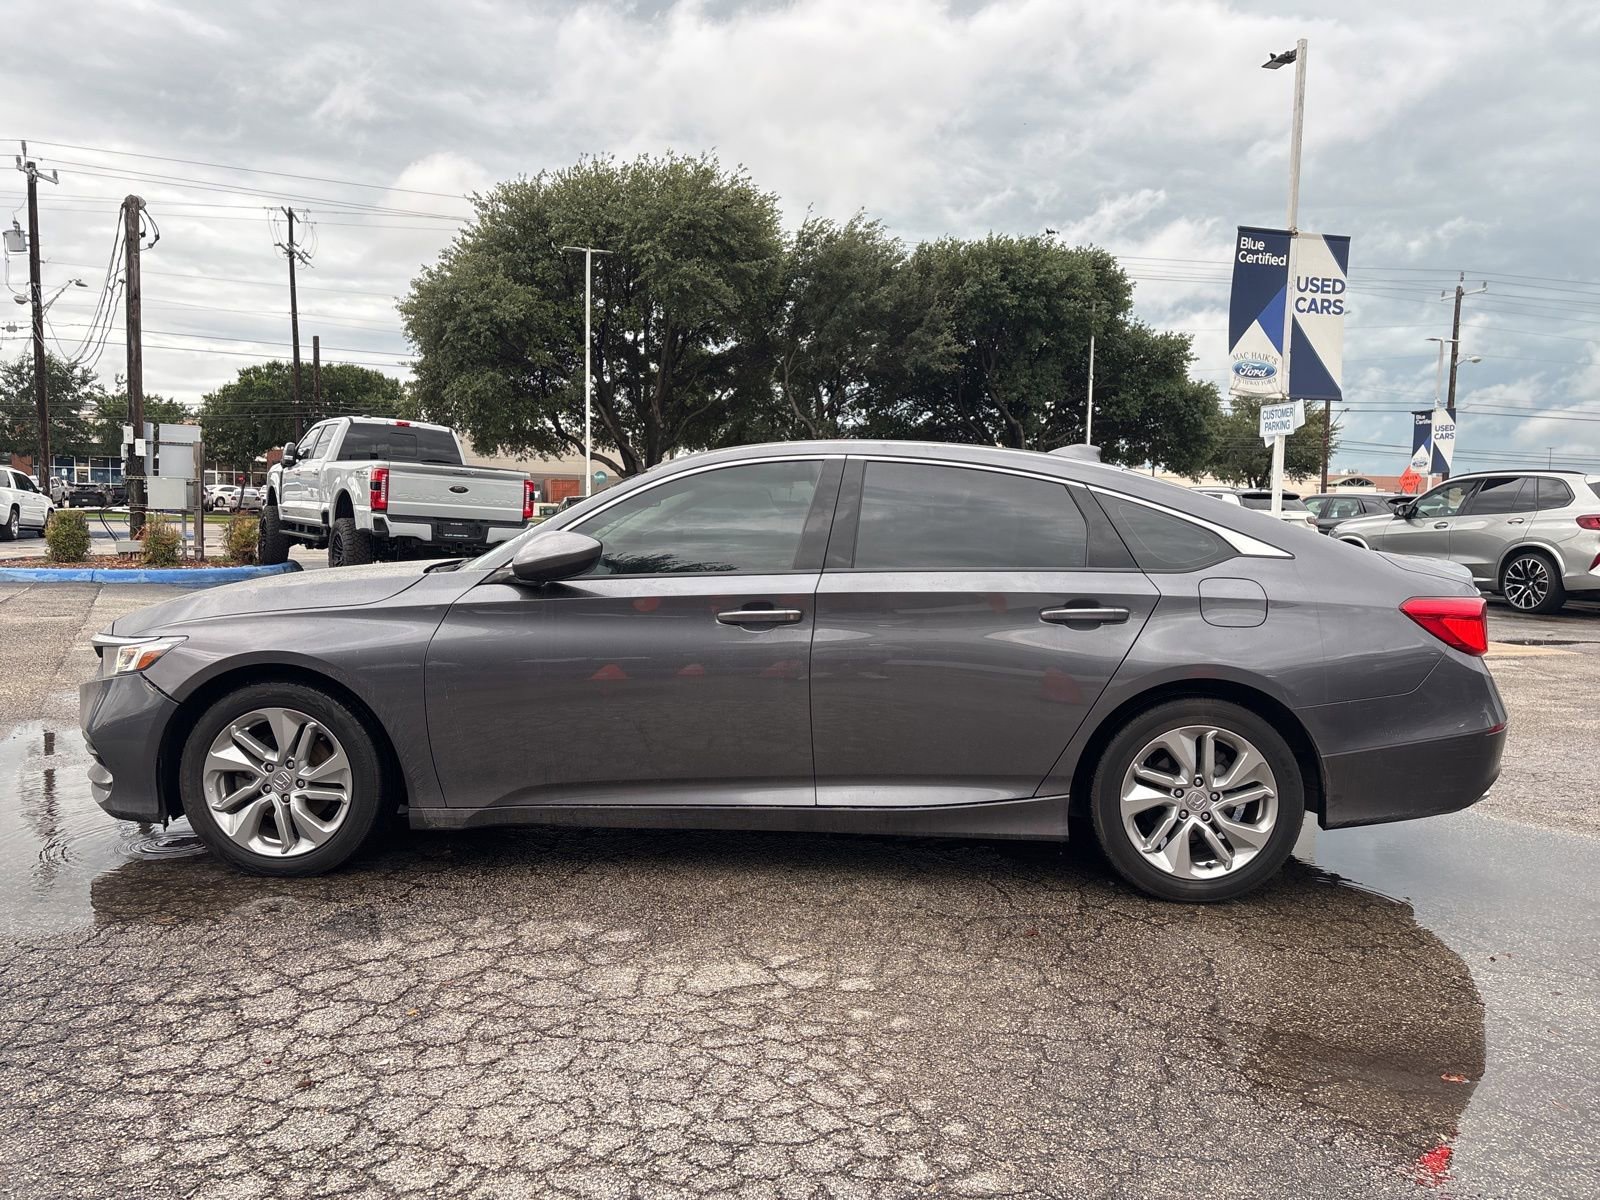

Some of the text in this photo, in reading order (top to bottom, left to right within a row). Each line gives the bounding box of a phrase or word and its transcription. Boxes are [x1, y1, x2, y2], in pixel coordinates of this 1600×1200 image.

[1240, 236, 1265, 251] Blue
[1238, 251, 1287, 266] Certified
[1296, 275, 1346, 295] USED
[1295, 296, 1344, 316] CARS
[1233, 352, 1249, 361] MAC
[1239, 362, 1268, 377] Ford
[1262, 407, 1294, 420] CUSTOMER
[1264, 420, 1291, 432] PARKING
